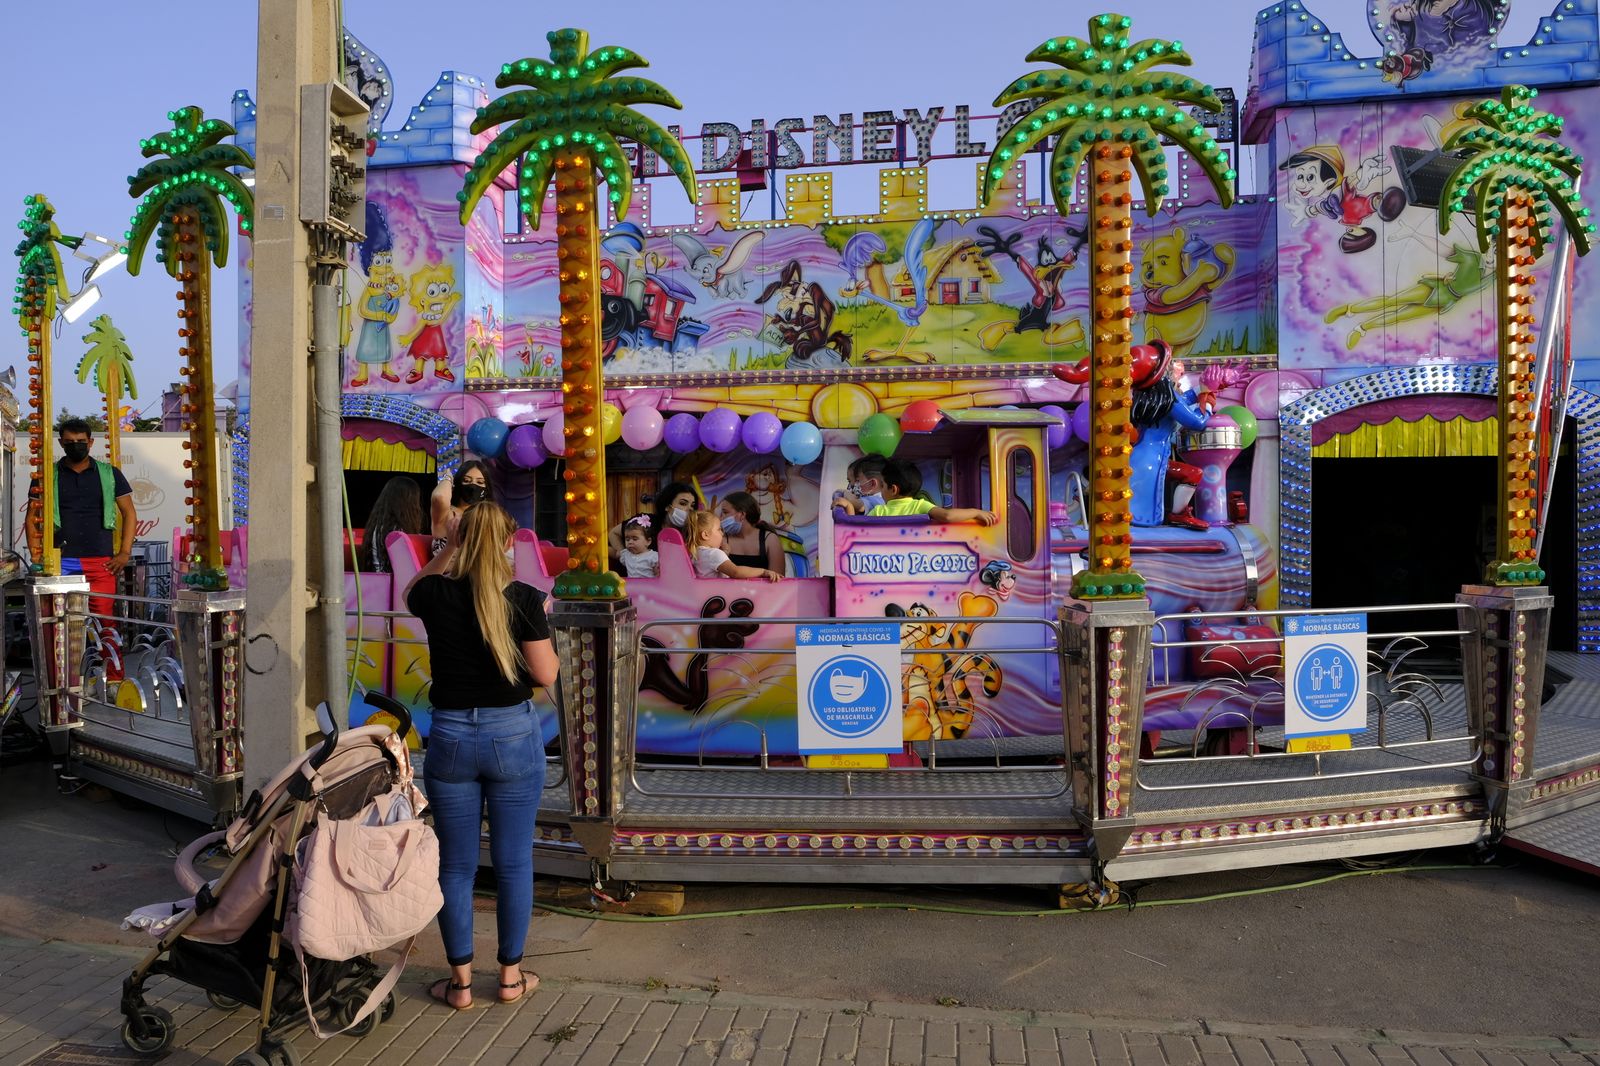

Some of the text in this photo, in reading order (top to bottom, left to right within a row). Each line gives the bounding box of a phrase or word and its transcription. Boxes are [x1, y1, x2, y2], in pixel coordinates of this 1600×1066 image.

[848, 552, 978, 575] UNION PACIFIC
[1303, 624, 1331, 632] NORMAS
[818, 634, 854, 642] NORMAS
